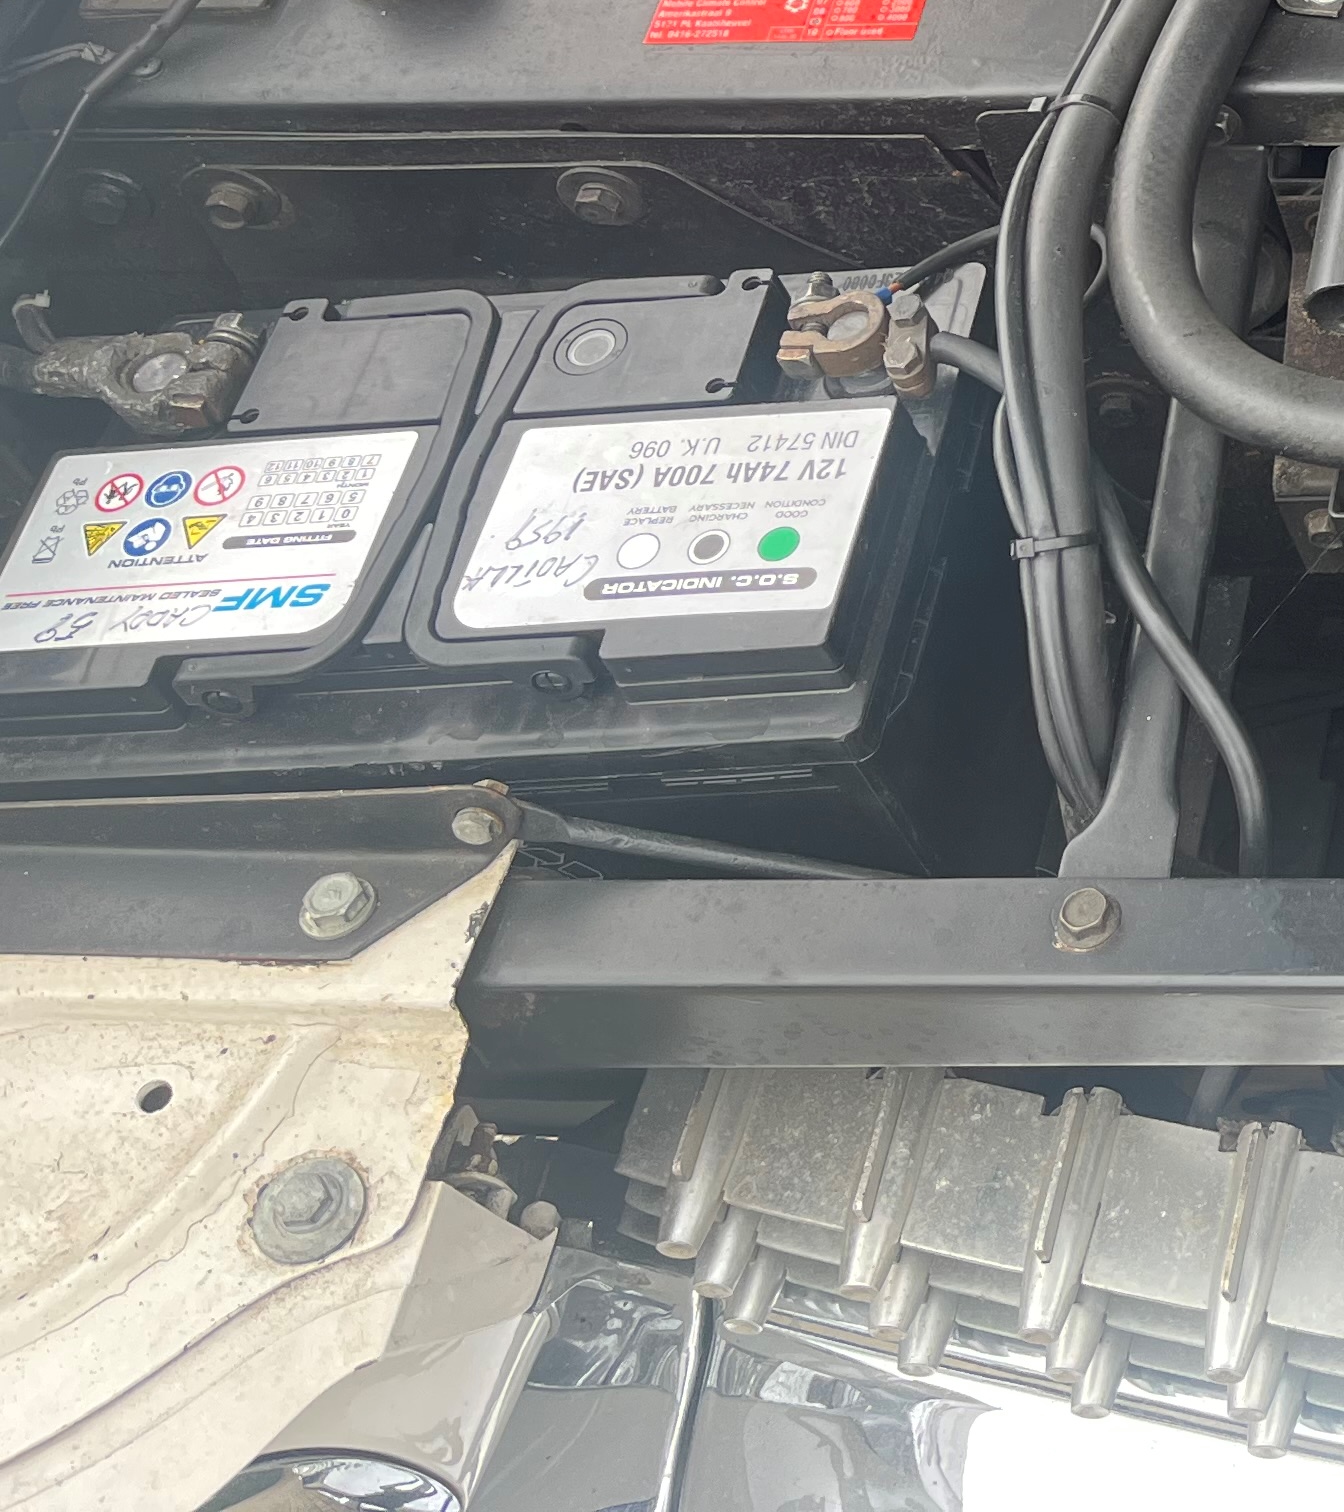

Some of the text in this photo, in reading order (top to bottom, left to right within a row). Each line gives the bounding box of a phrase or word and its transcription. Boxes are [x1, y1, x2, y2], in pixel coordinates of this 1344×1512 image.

[629, 430, 859, 459] DIN 57412 U.K. 096
[573, 458, 847, 493] 12V 74Ah 700A (SAE)
[255, 492, 358, 507] 5 6 7 8 9
[689, 501, 756, 512] NECESSARY
[764, 499, 826, 509] CONDITION
[246, 509, 350, 524] 0 1 2 3 4
[626, 506, 677, 515] BATTERY
[689, 512, 748, 522] CHARGING
[774, 510, 808, 518] GOOD
[622, 516, 674, 526] REPLACE
[505, 508, 587, 551] 1959
[246, 533, 332, 546] FITTING DATE
[108, 555, 208, 568] ATTENTION
[601, 573, 799, 594] S.O.C. INDICATOR
[1, 589, 222, 610] SEALED MAINTENANCE FREE
[212, 584, 330, 612] SMF
